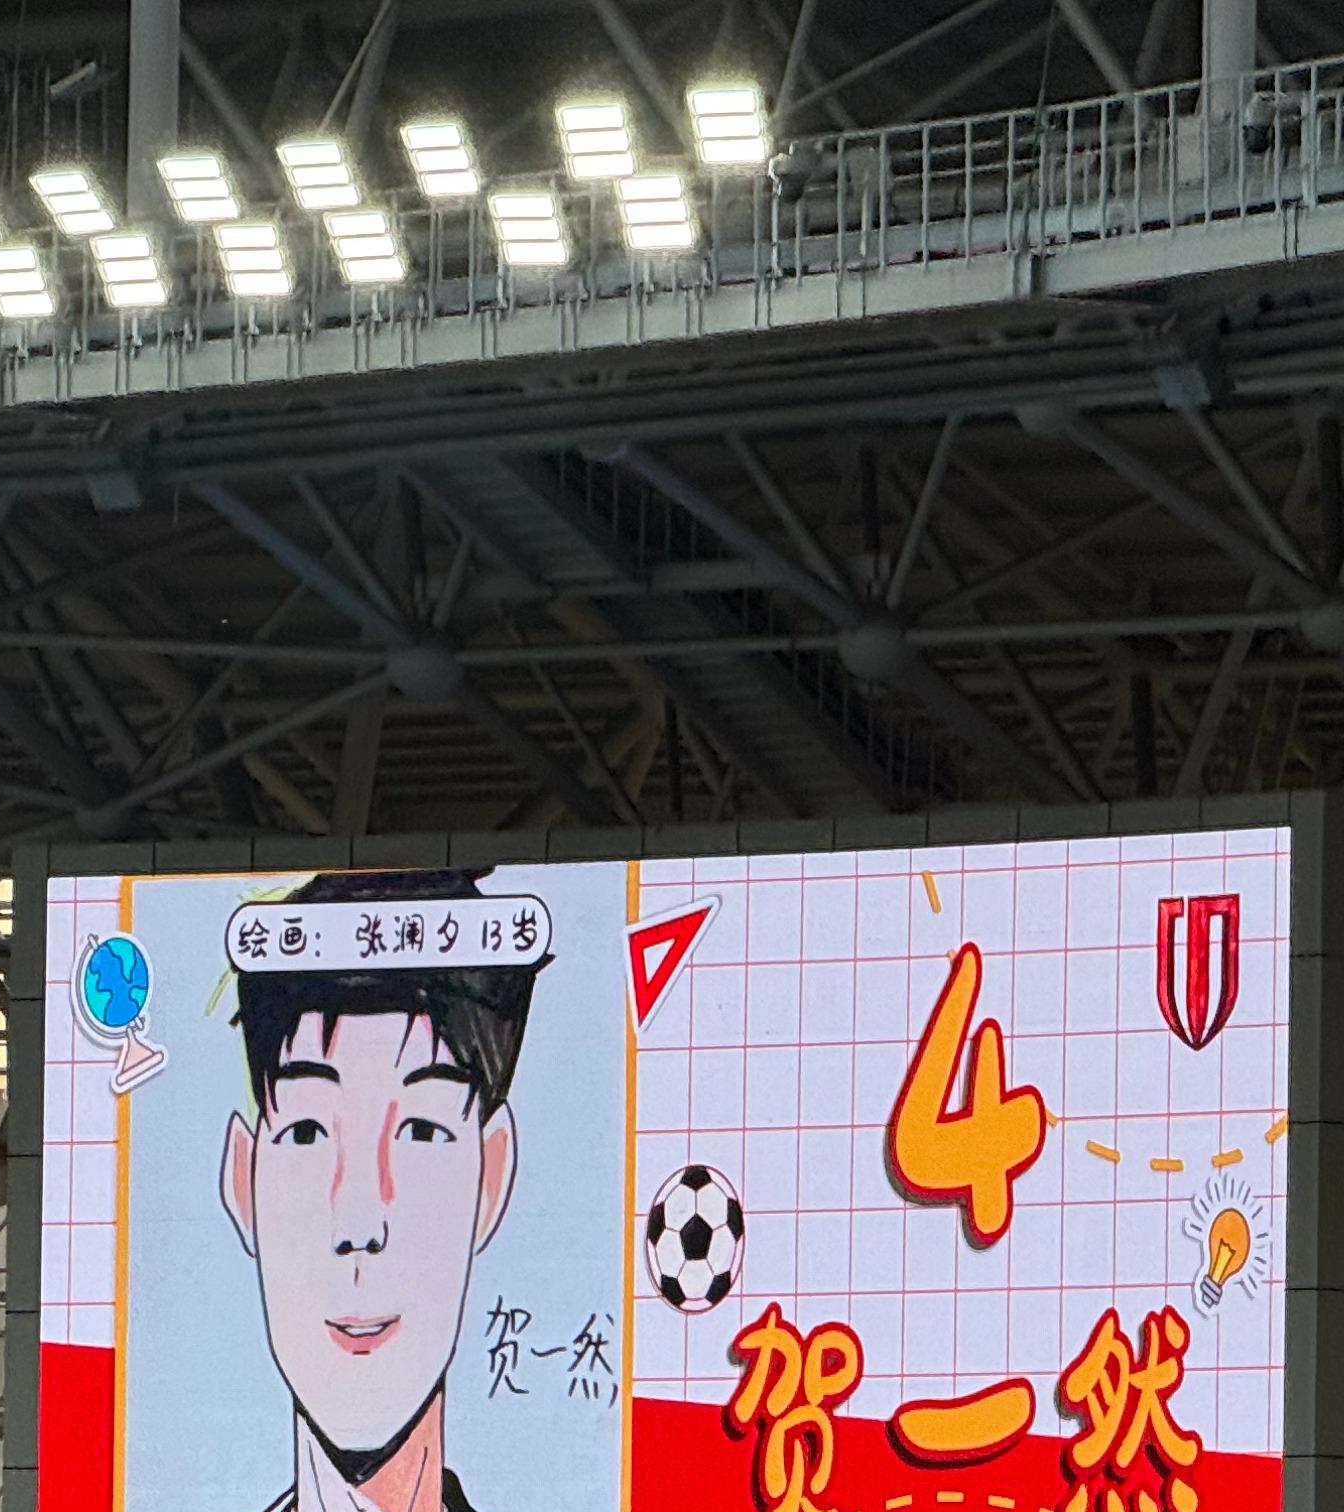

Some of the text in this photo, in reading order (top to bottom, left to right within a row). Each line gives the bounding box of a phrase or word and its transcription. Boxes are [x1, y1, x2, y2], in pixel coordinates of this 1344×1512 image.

[888, 941, 1047, 1248] 4
[484, 1294, 619, 1408] 贺一然
